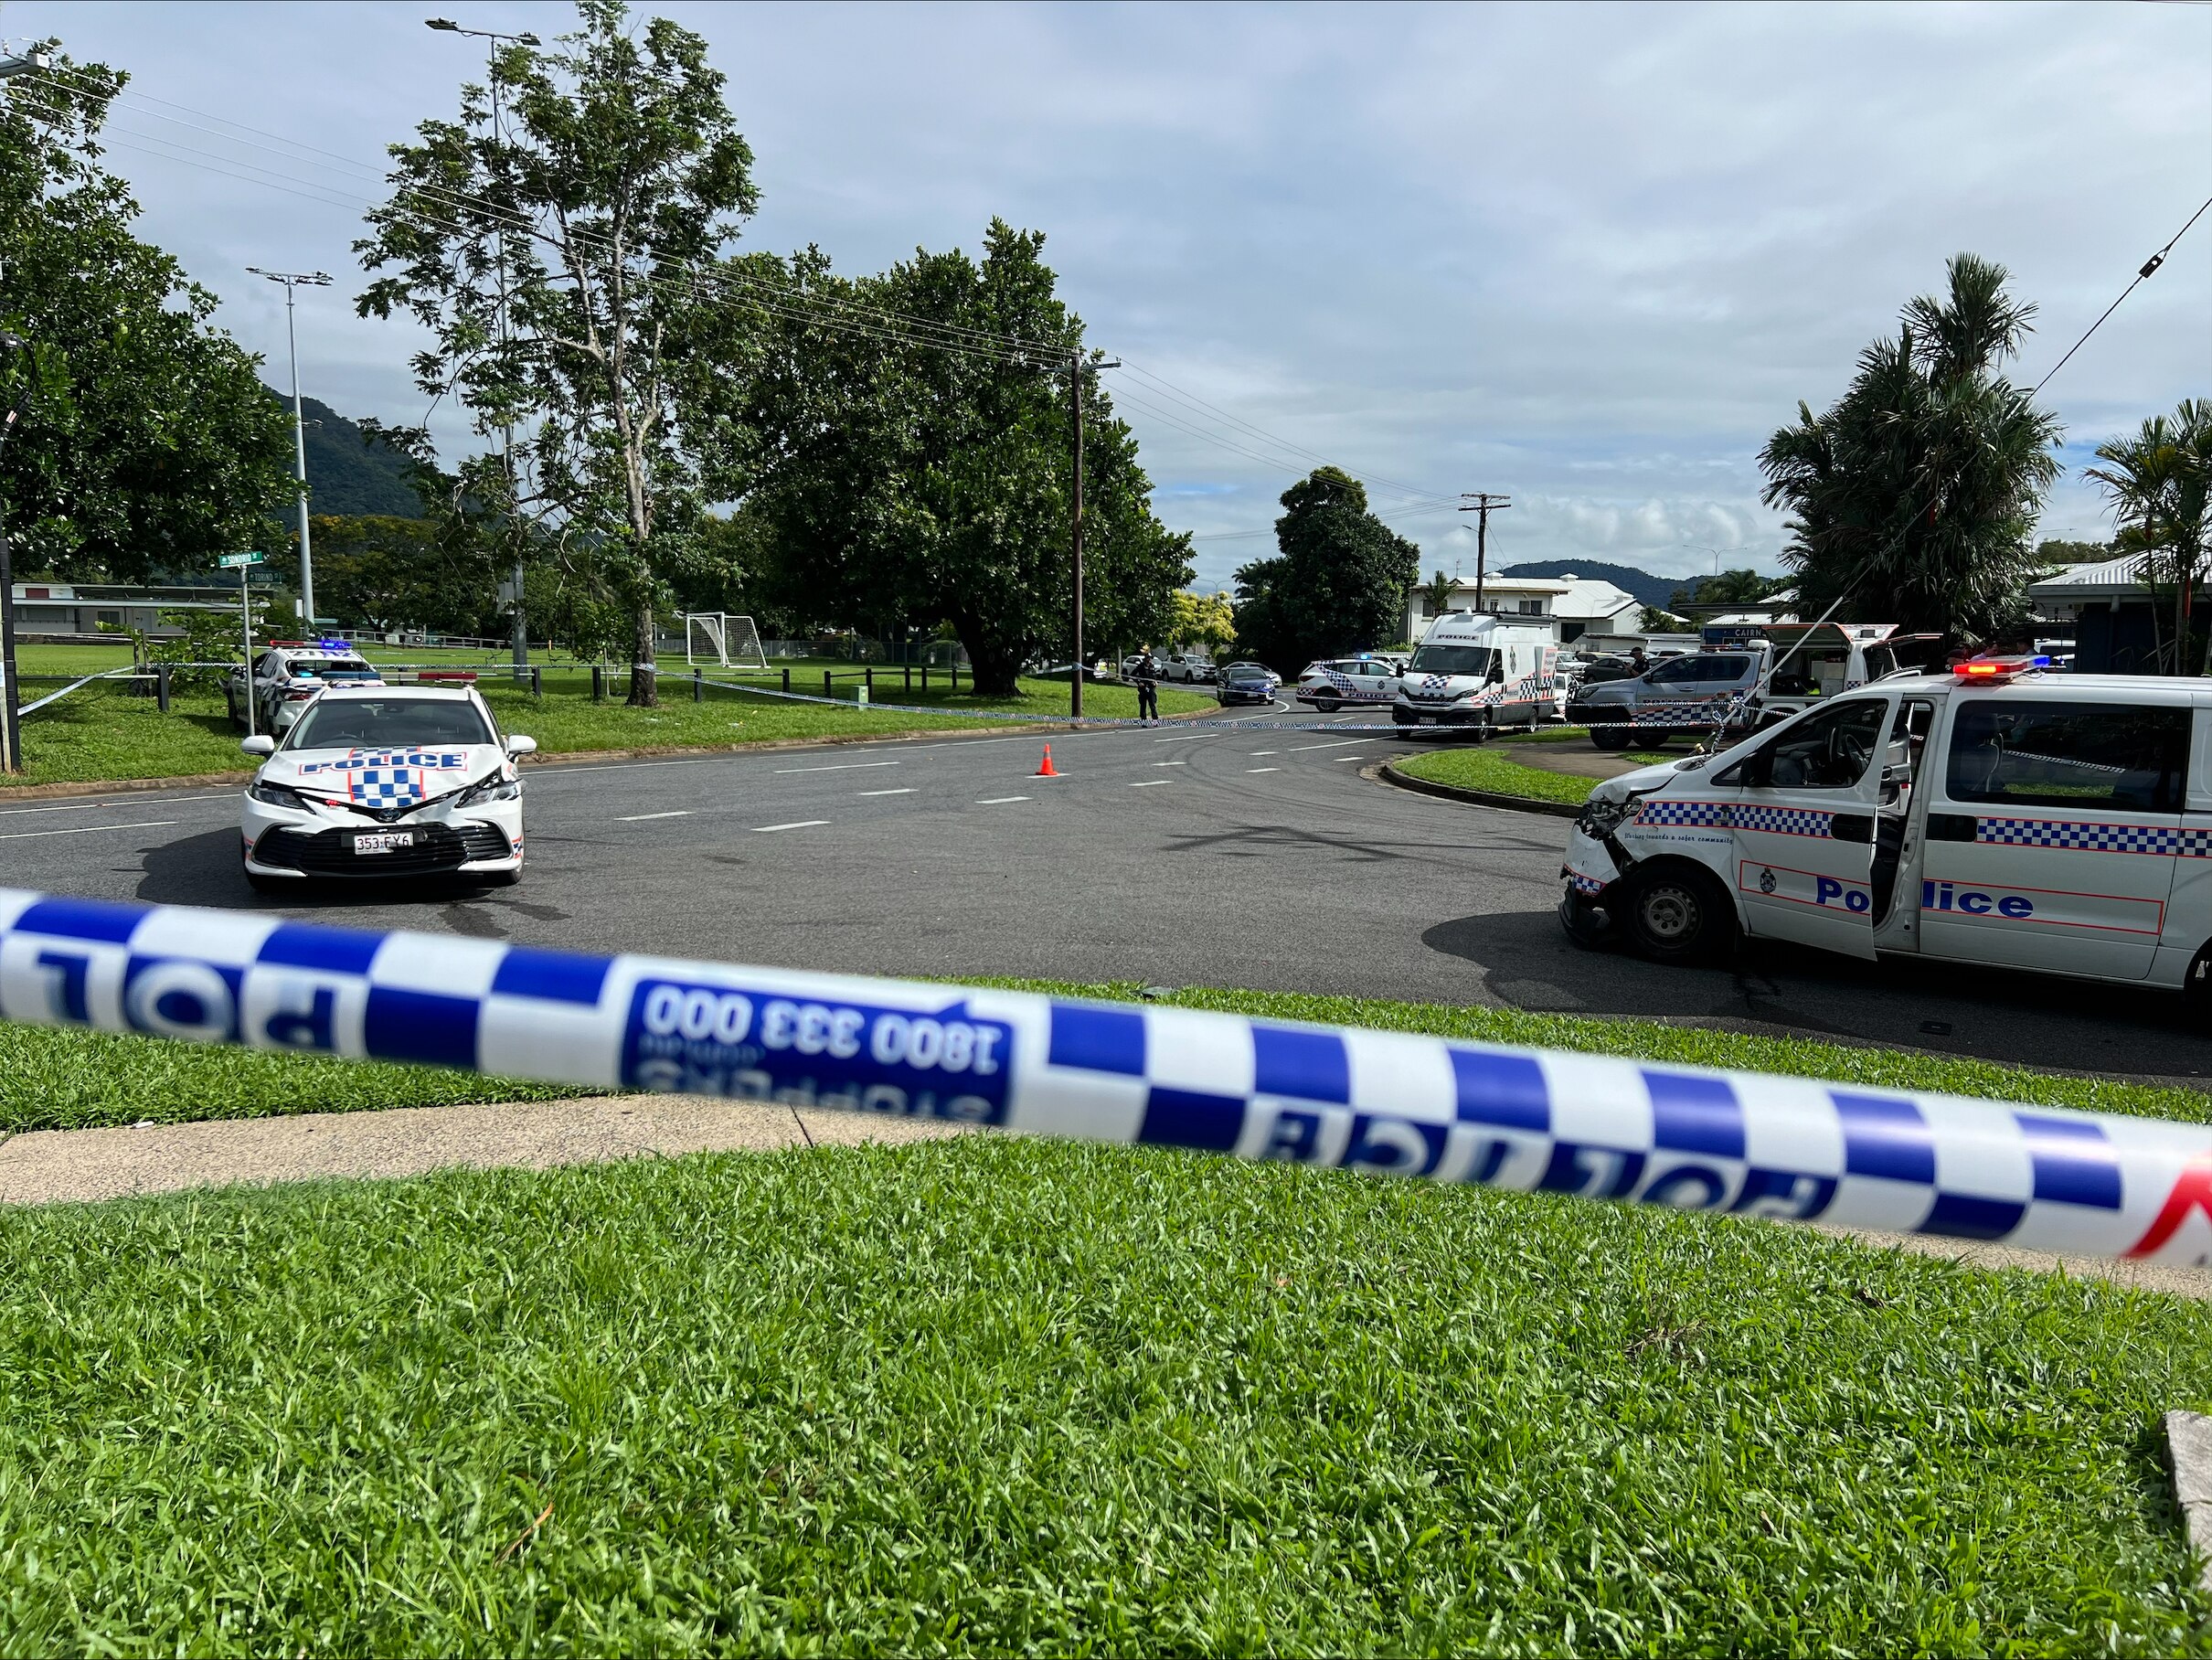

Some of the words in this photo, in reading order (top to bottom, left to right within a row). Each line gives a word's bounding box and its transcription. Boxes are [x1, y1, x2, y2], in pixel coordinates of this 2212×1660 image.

[300, 752, 467, 775] POLICE
[1697, 836, 1733, 846] community
[643, 984, 753, 1046] 000
[760, 1000, 866, 1059] 333
[869, 1013, 1003, 1076] 1800
